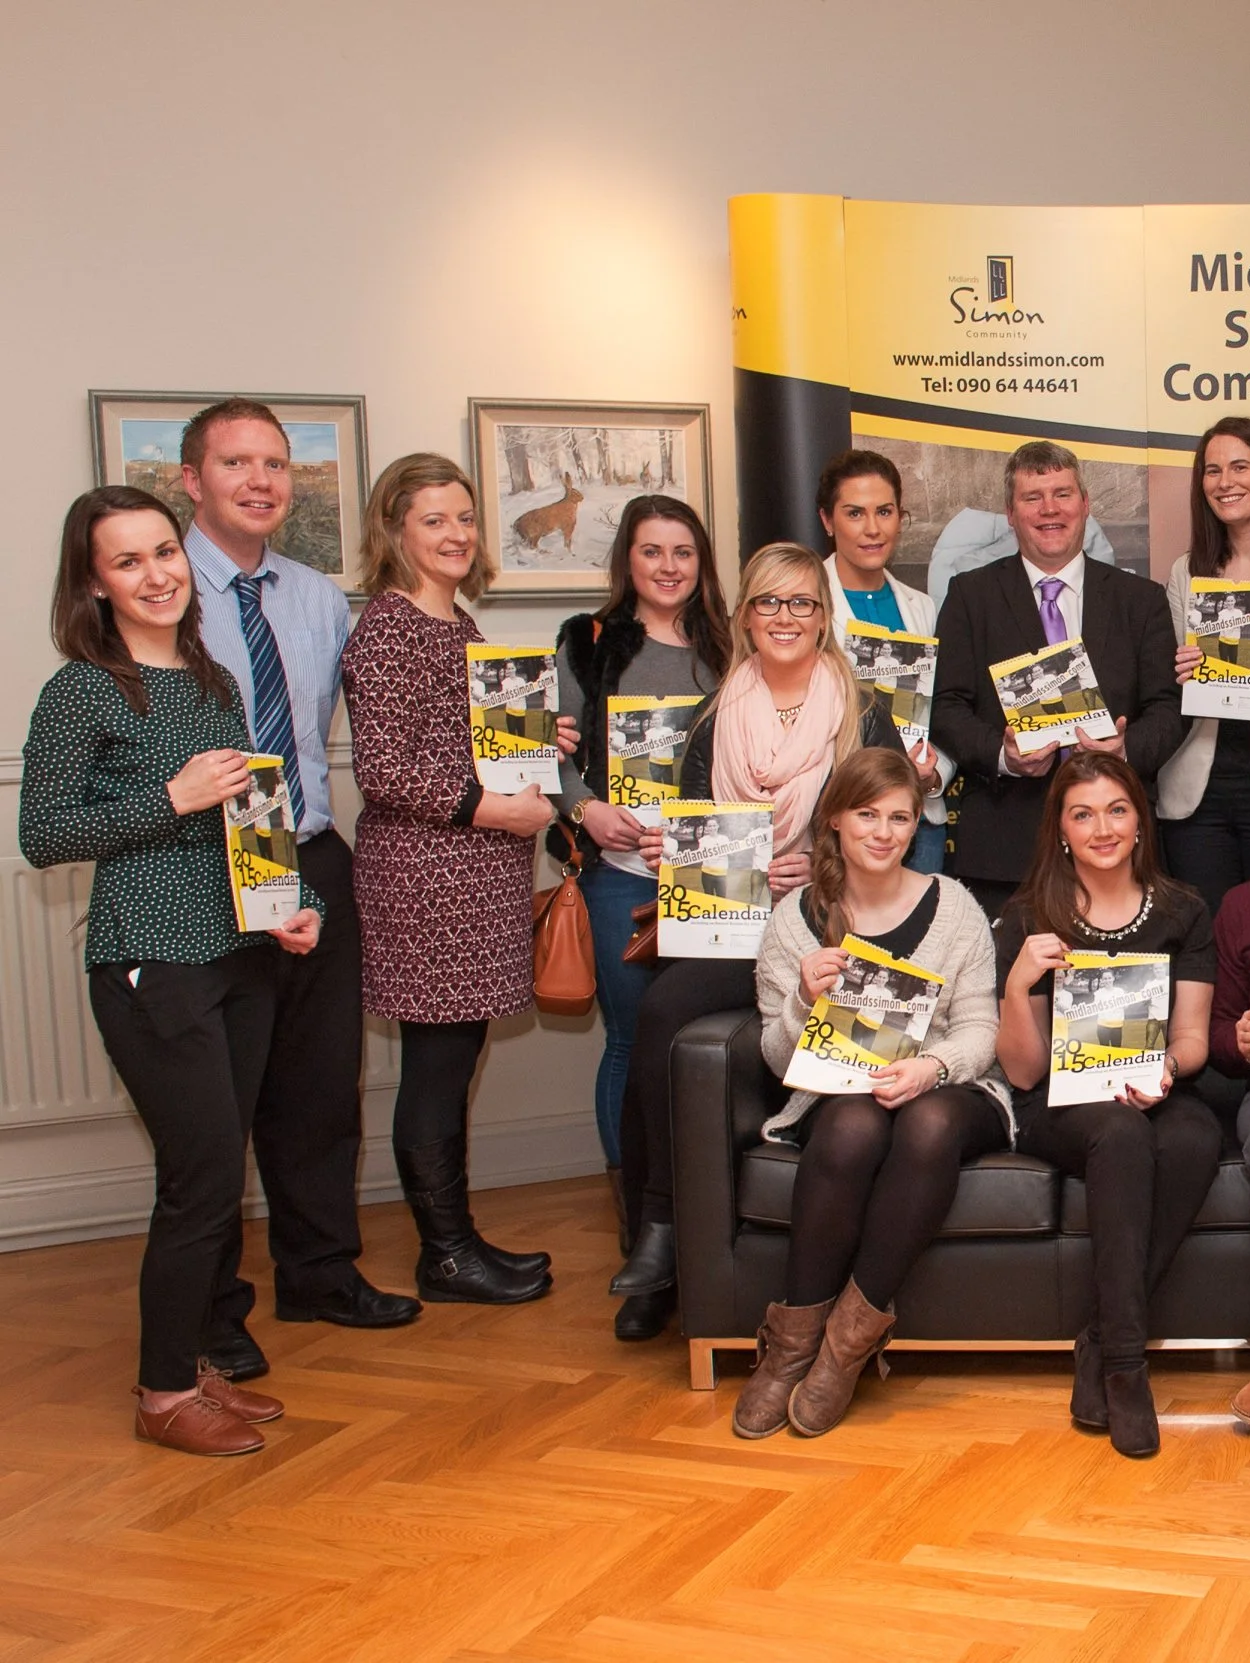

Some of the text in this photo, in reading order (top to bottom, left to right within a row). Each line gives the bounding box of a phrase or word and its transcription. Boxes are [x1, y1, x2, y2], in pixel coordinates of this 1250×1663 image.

[947, 275, 980, 284] Midlands
[949, 286, 1045, 325] Simon
[965, 329, 1028, 340] Community
[893, 351, 1105, 368] www.midlandssimon.com
[920, 377, 1079, 393] Tel: 090 64 44641
[1008, 715, 1034, 728] 20
[1038, 711, 1109, 729] Calendar
[472, 725, 495, 742] 20
[479, 738, 559, 761] 15 Calendar
[609, 774, 636, 790] 20
[615, 786, 641, 809] 15
[233, 848, 251, 867] 20
[254, 869, 300, 887] Calendar
[659, 884, 687, 901] 20
[663, 896, 772, 922] 15 Calendar
[804, 1016, 835, 1040] 20
[802, 1029, 834, 1060] 15
[826, 1046, 880, 1071] Calen
[1053, 1038, 1082, 1054] 20
[1057, 1049, 1086, 1074] 15
[1084, 1051, 1165, 1069] Calendar
